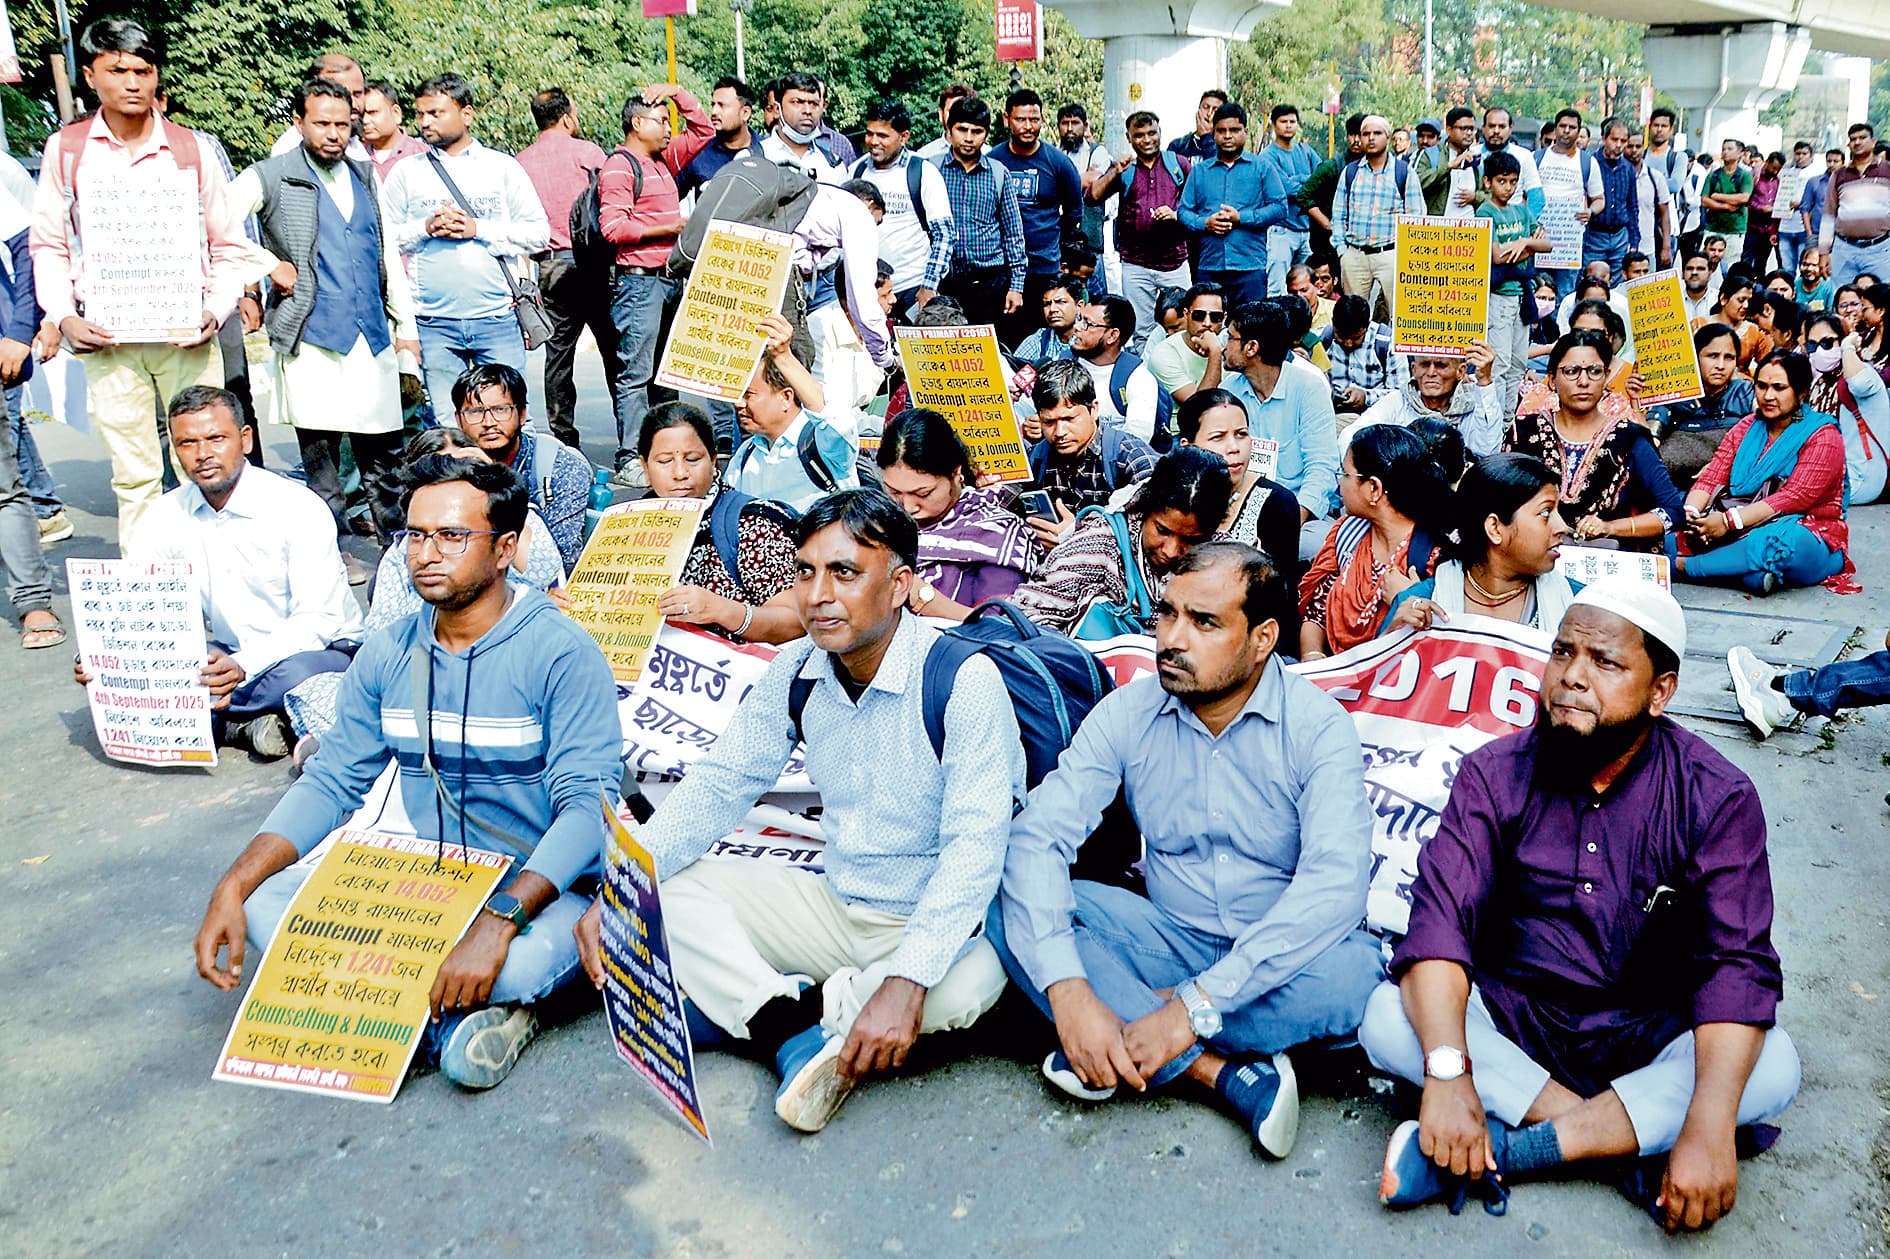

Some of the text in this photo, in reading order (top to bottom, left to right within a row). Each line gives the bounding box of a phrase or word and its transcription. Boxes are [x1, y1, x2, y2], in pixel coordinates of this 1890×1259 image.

[101, 267, 150, 281] Contempt
[1399, 272, 1449, 286] Contempt
[111, 284, 167, 296] September
[687, 286, 738, 311] Contempt
[923, 328, 960, 338] PRIMARY
[961, 327, 990, 337] (2016)
[1397, 316, 1445, 331] Counselling
[1454, 320, 1484, 333] Joining
[670, 338, 719, 364] Counselling
[916, 391, 1005, 408] Contempt মামলার
[978, 446, 985, 456] &
[986, 441, 1020, 456] Joining
[615, 553, 666, 567] রায়দানের
[632, 573, 671, 587] মামলার
[605, 633, 612, 645] &
[614, 632, 653, 649] Joining
[101, 673, 150, 692] Contempt
[648, 644, 731, 702] মুহূর্তে
[95, 692, 204, 710] 4th September 2025
[341, 831, 388, 851] UPPER
[389, 837, 452, 859] PRIMARY
[345, 848, 474, 883] নিয়োগে ডিভিশন
[334, 873, 459, 904] বেঞ্চের 14,052
[317, 896, 443, 927] চূড়ান্ত রায়দানের
[287, 913, 449, 954] Contempt মামলার
[284, 940, 343, 969] নির্দেশে
[280, 970, 401, 1008] প্রার্থীর অবিলম্বে
[245, 999, 414, 1046] Counselling & Joining
[295, 1035, 345, 1061] করতে
[350, 1047, 389, 1069] হবে।
